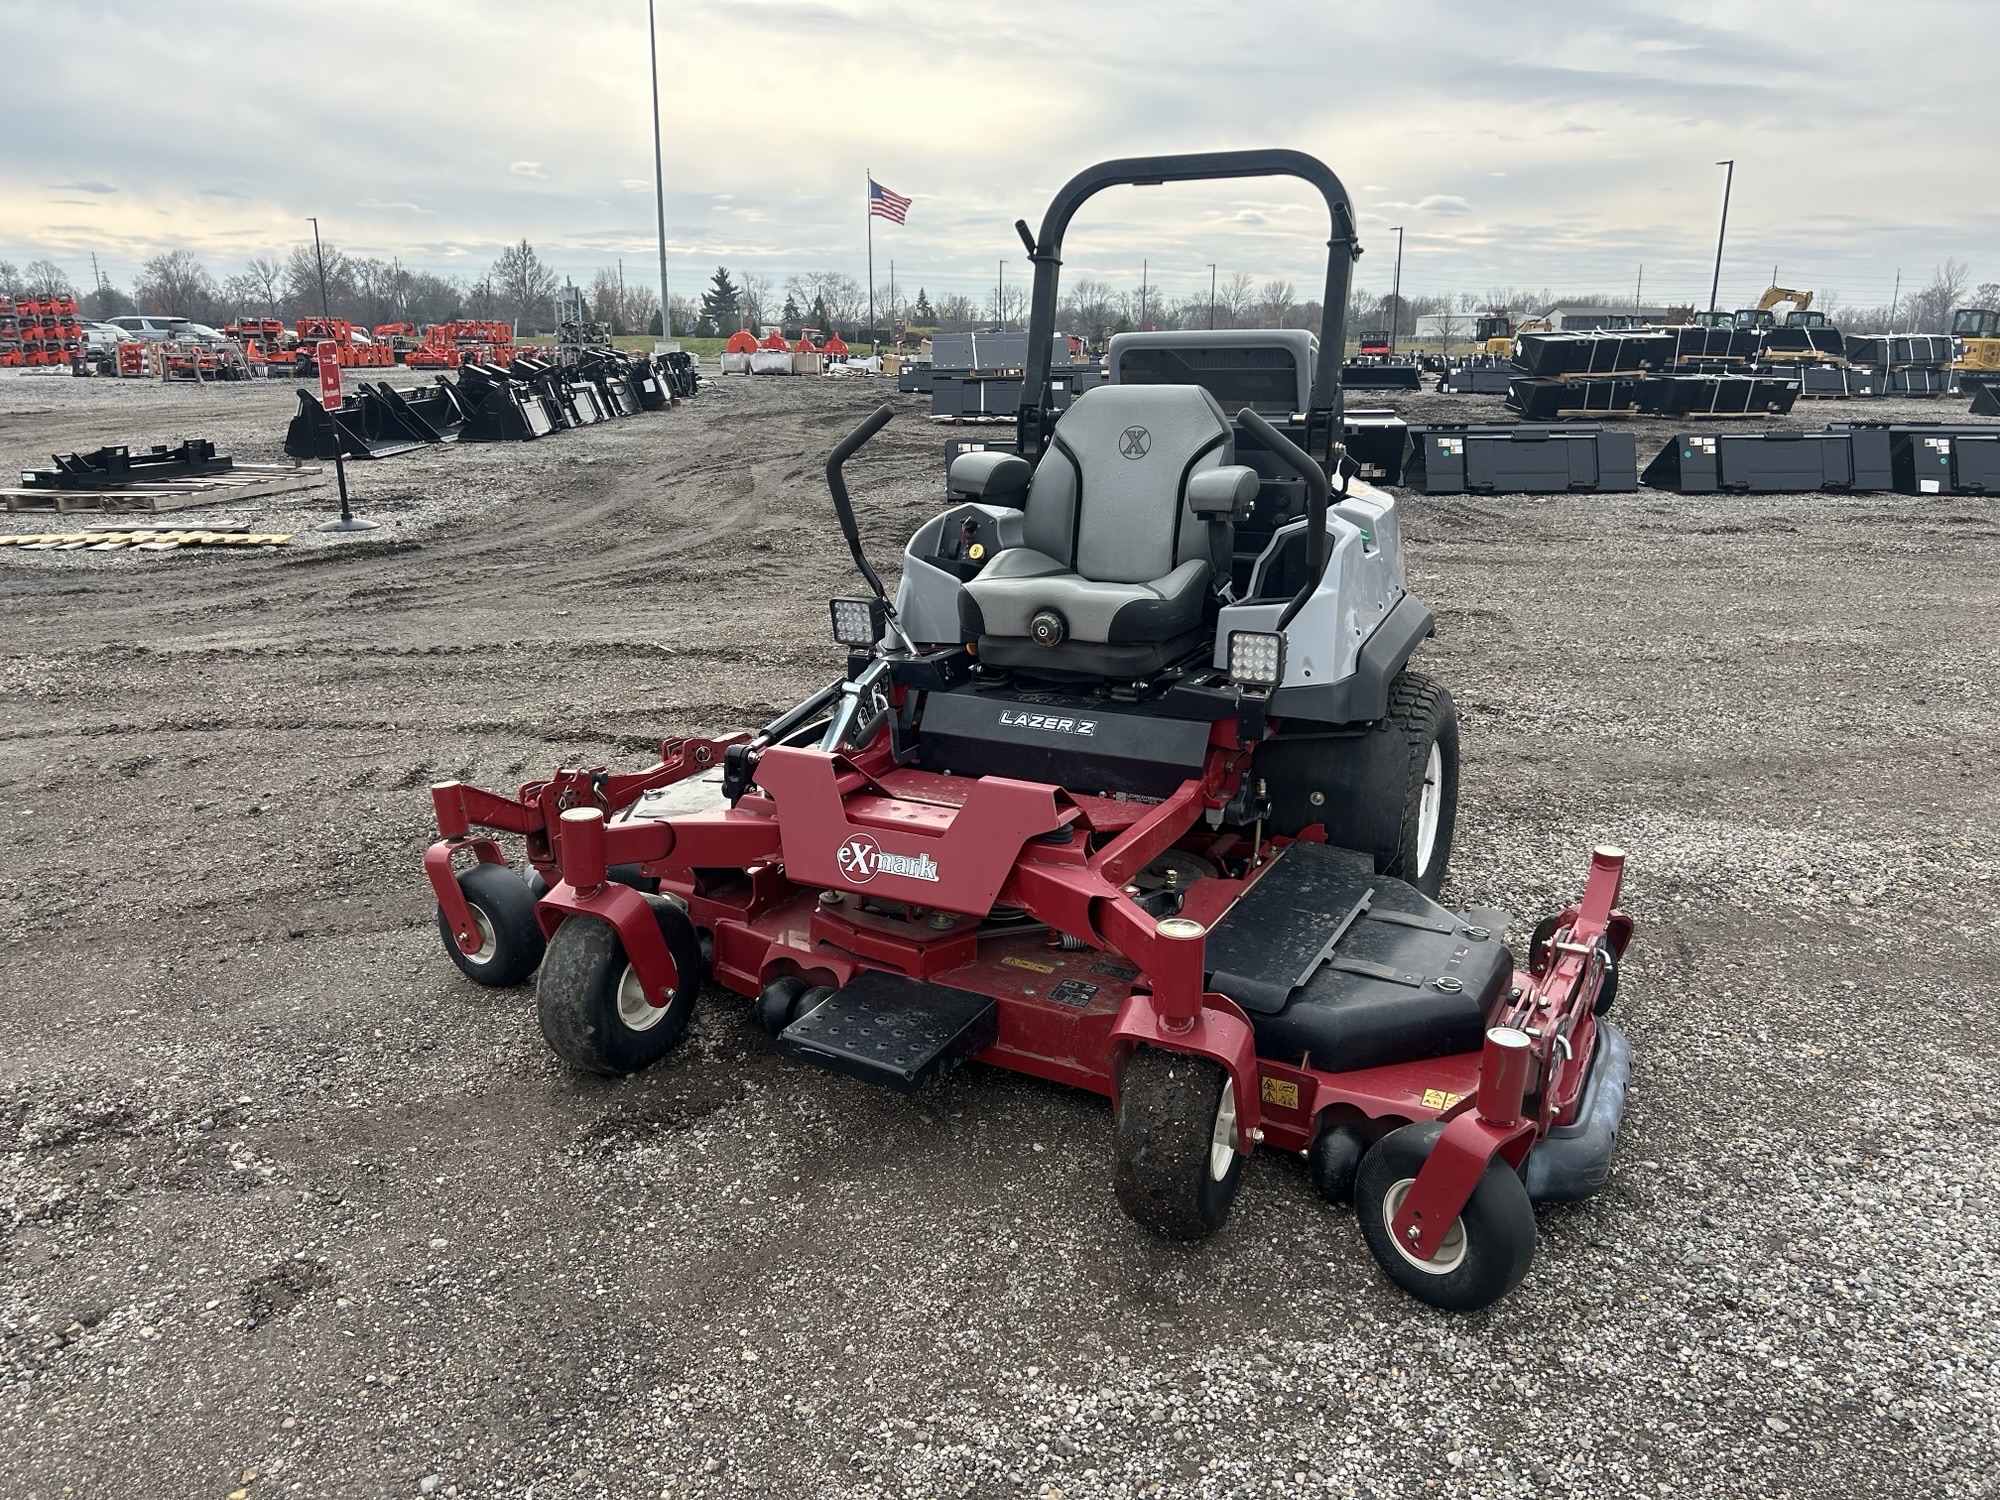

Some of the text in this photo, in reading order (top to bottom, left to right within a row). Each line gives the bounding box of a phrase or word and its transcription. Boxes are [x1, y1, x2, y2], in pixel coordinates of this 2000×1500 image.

[1122, 430, 1147, 454] X
[1000, 710, 1096, 735] LAZER Z
[838, 841, 938, 880] eXmark
